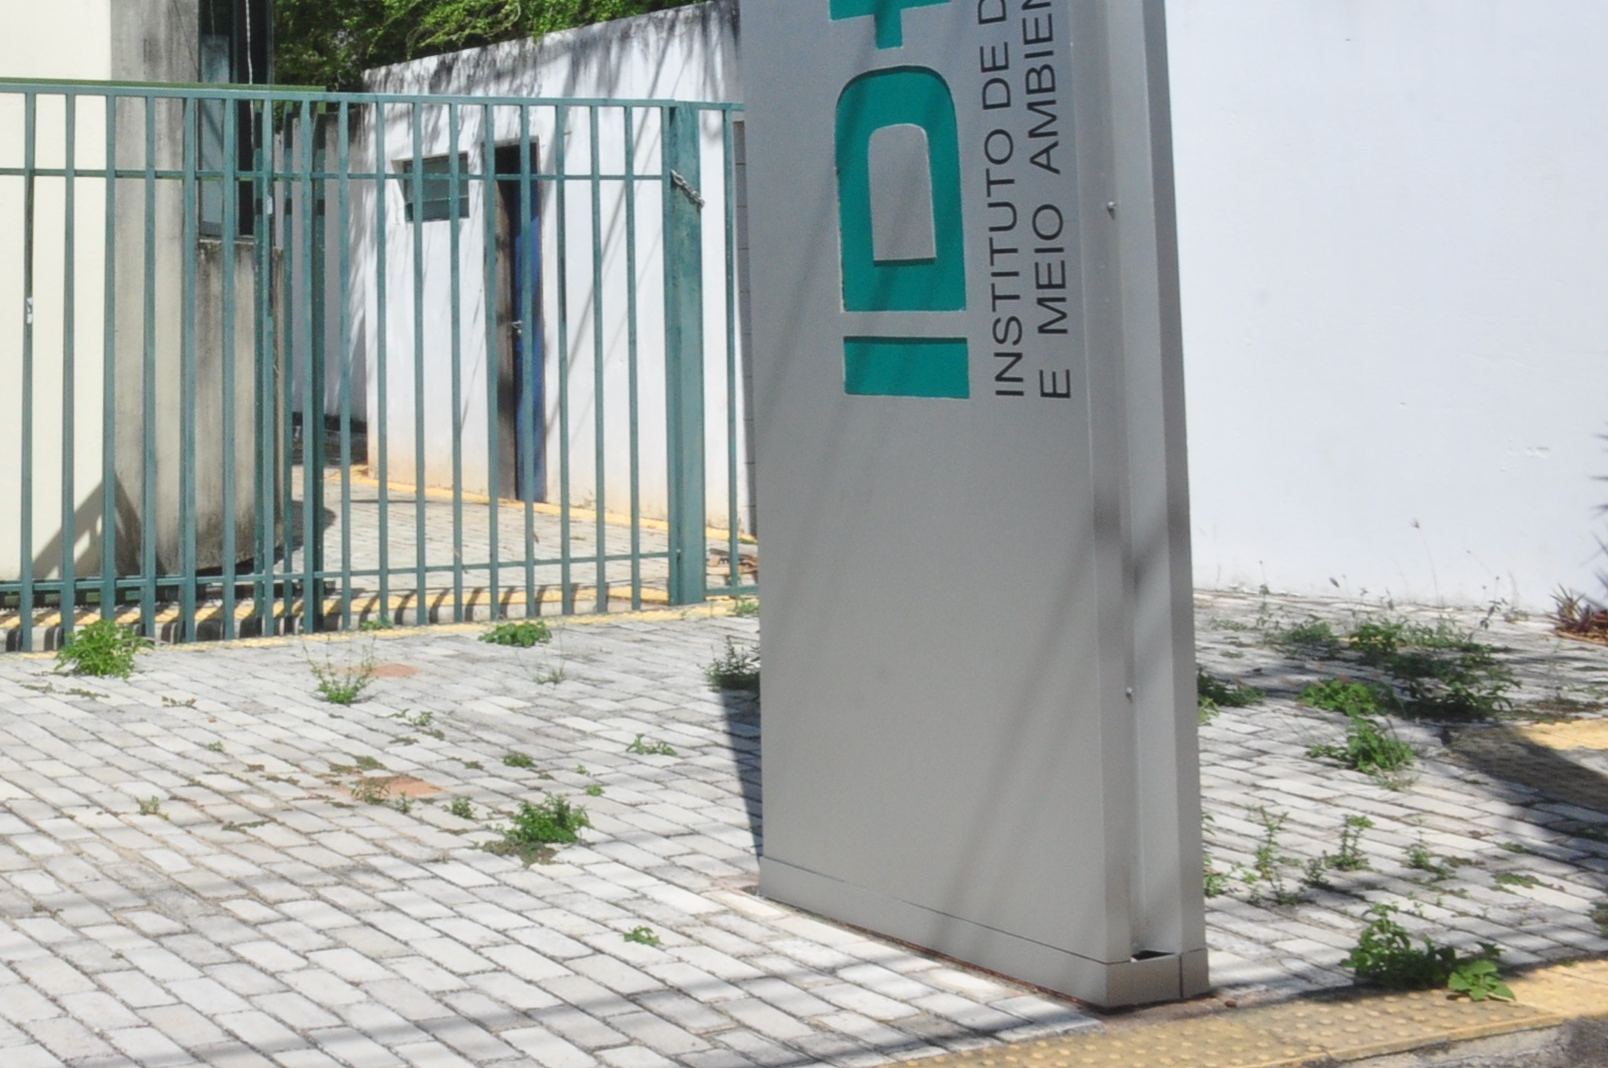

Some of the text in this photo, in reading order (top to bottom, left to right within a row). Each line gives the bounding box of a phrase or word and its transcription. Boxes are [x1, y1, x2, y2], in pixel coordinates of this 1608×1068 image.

[979, 41, 1012, 111] DE
[983, 128, 1025, 398] INSTITUTO
[1031, 203, 1069, 335] MEIO
[1039, 368, 1072, 399] E
